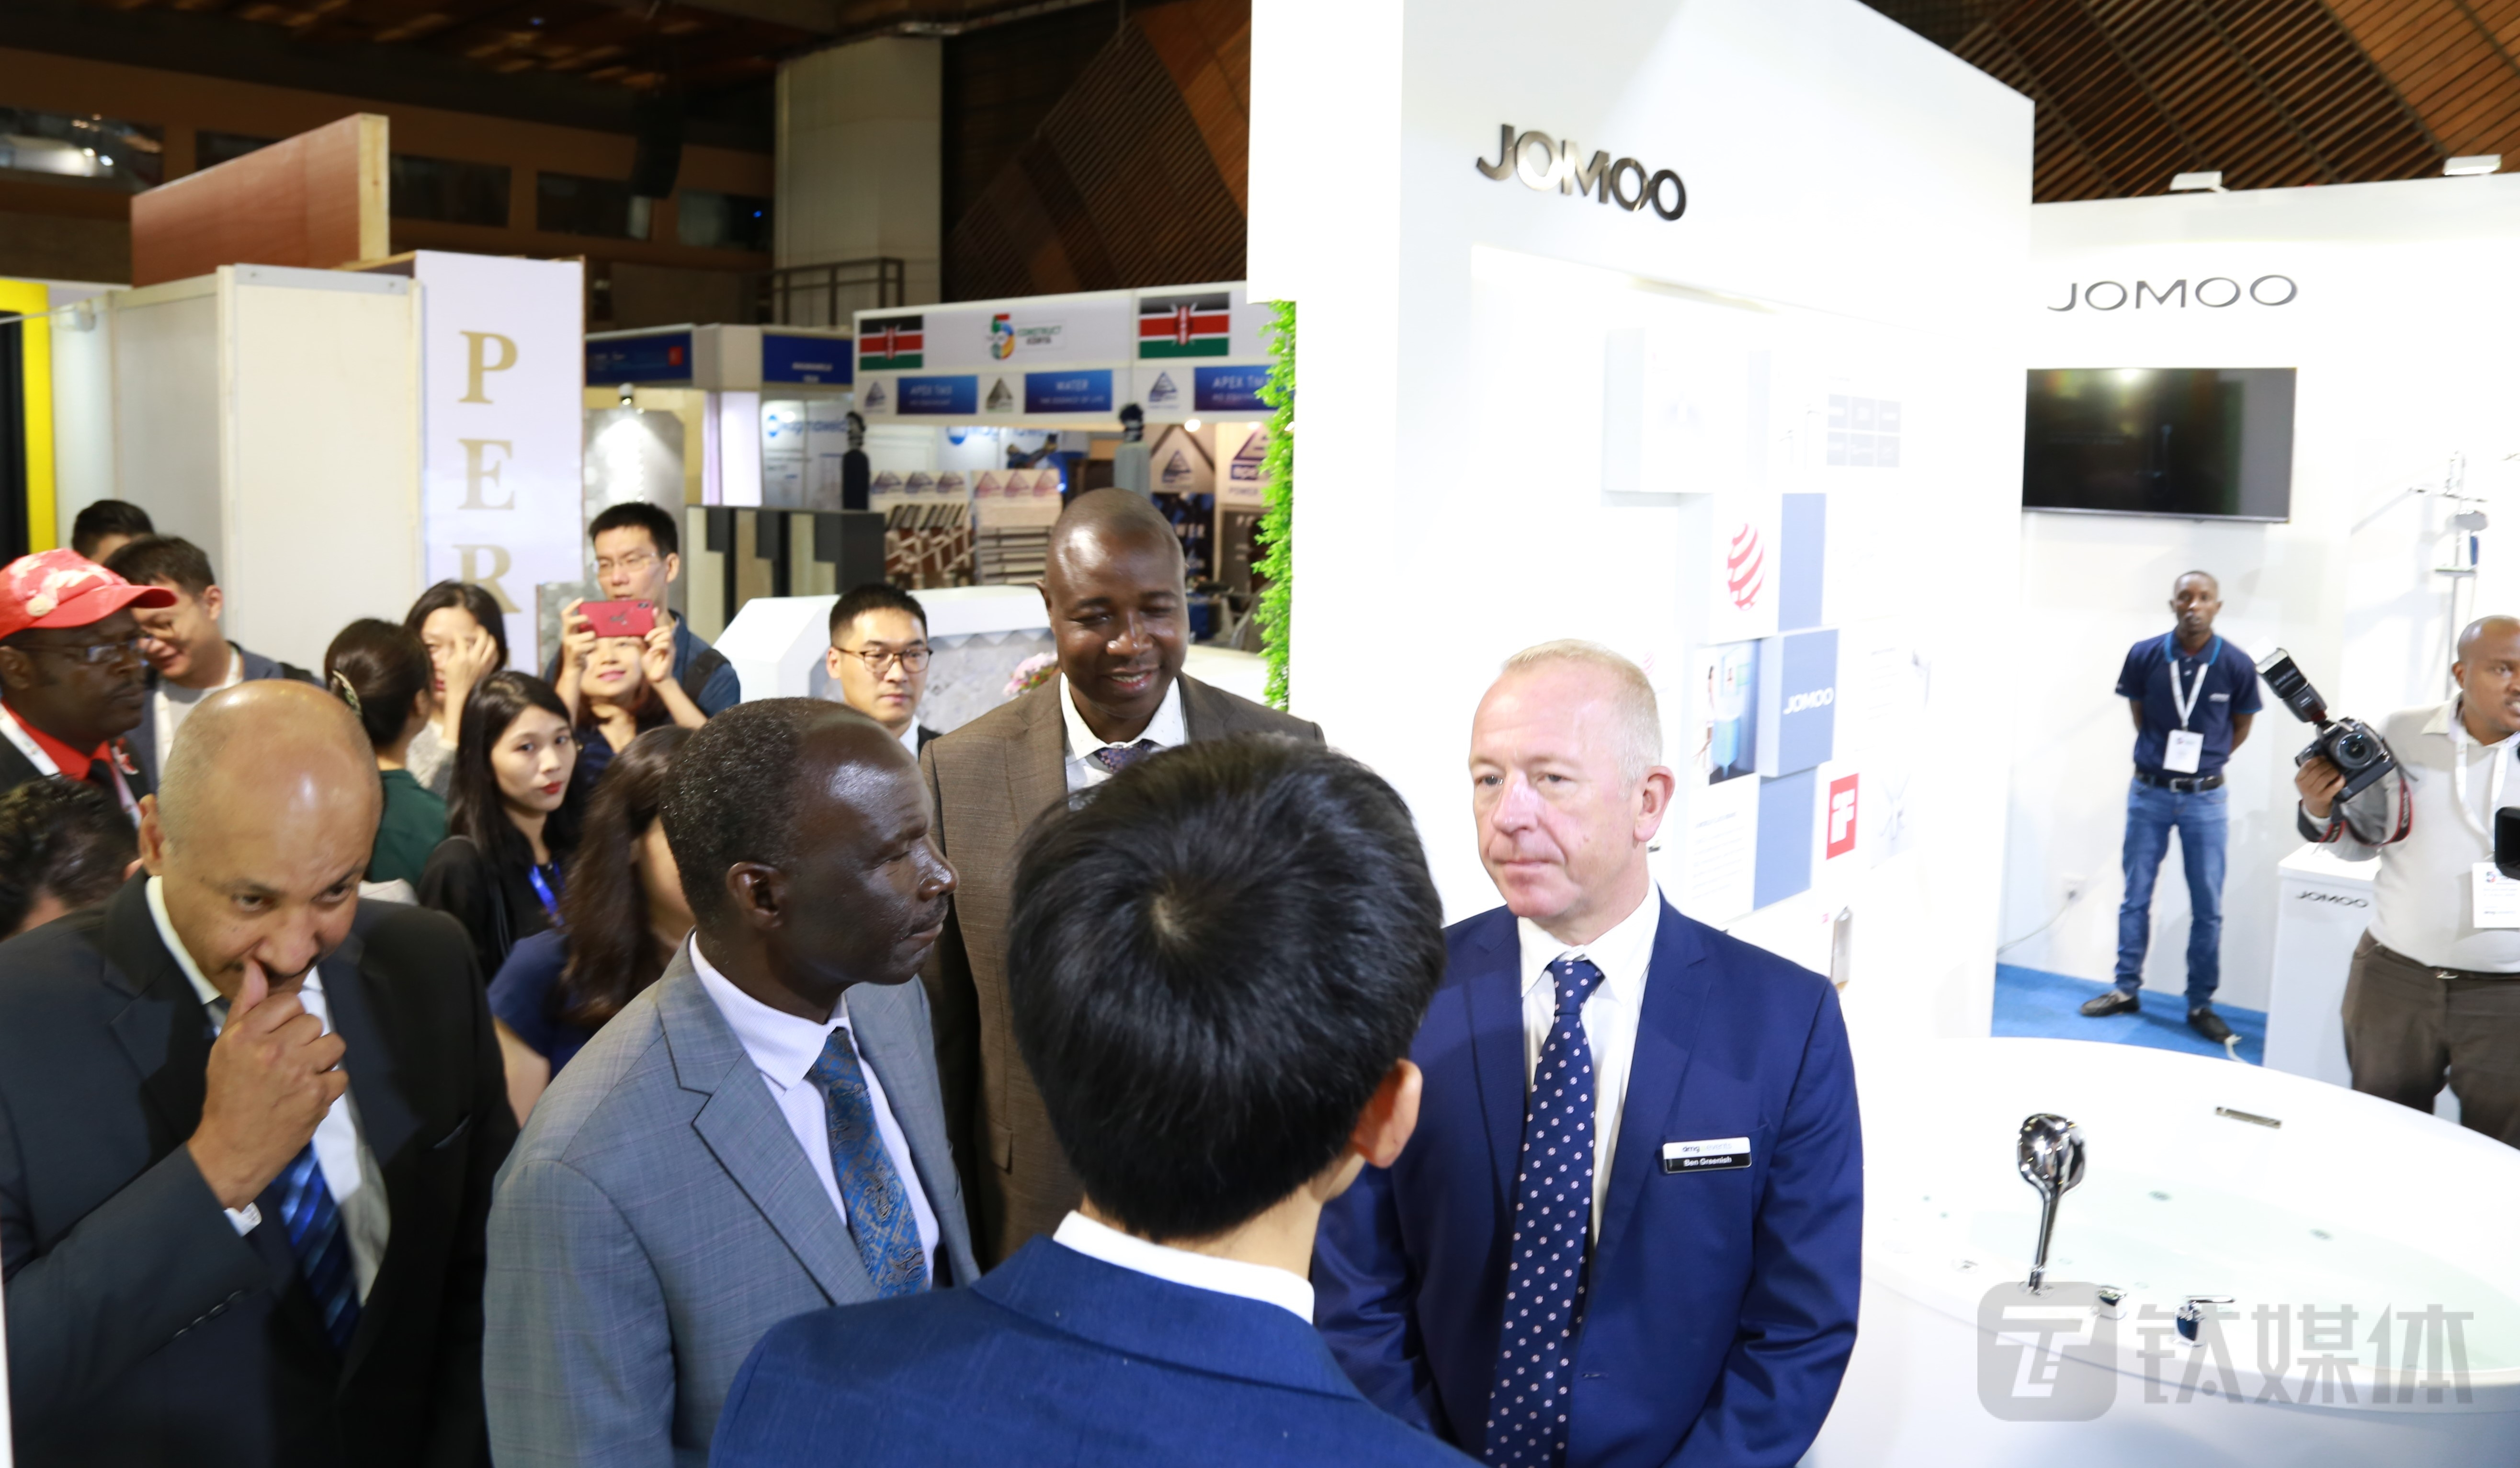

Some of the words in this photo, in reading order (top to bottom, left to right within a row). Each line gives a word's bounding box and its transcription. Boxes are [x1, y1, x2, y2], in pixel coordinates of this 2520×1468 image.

[1476, 123, 1686, 221] JOMOO
[2047, 274, 2298, 312] JOMOO
[1783, 687, 1834, 715] JOMOO
[2297, 891, 2368, 908] JOMOO
[1683, 1159, 1699, 1167] Ben
[1700, 1156, 1732, 1166] Greenish
